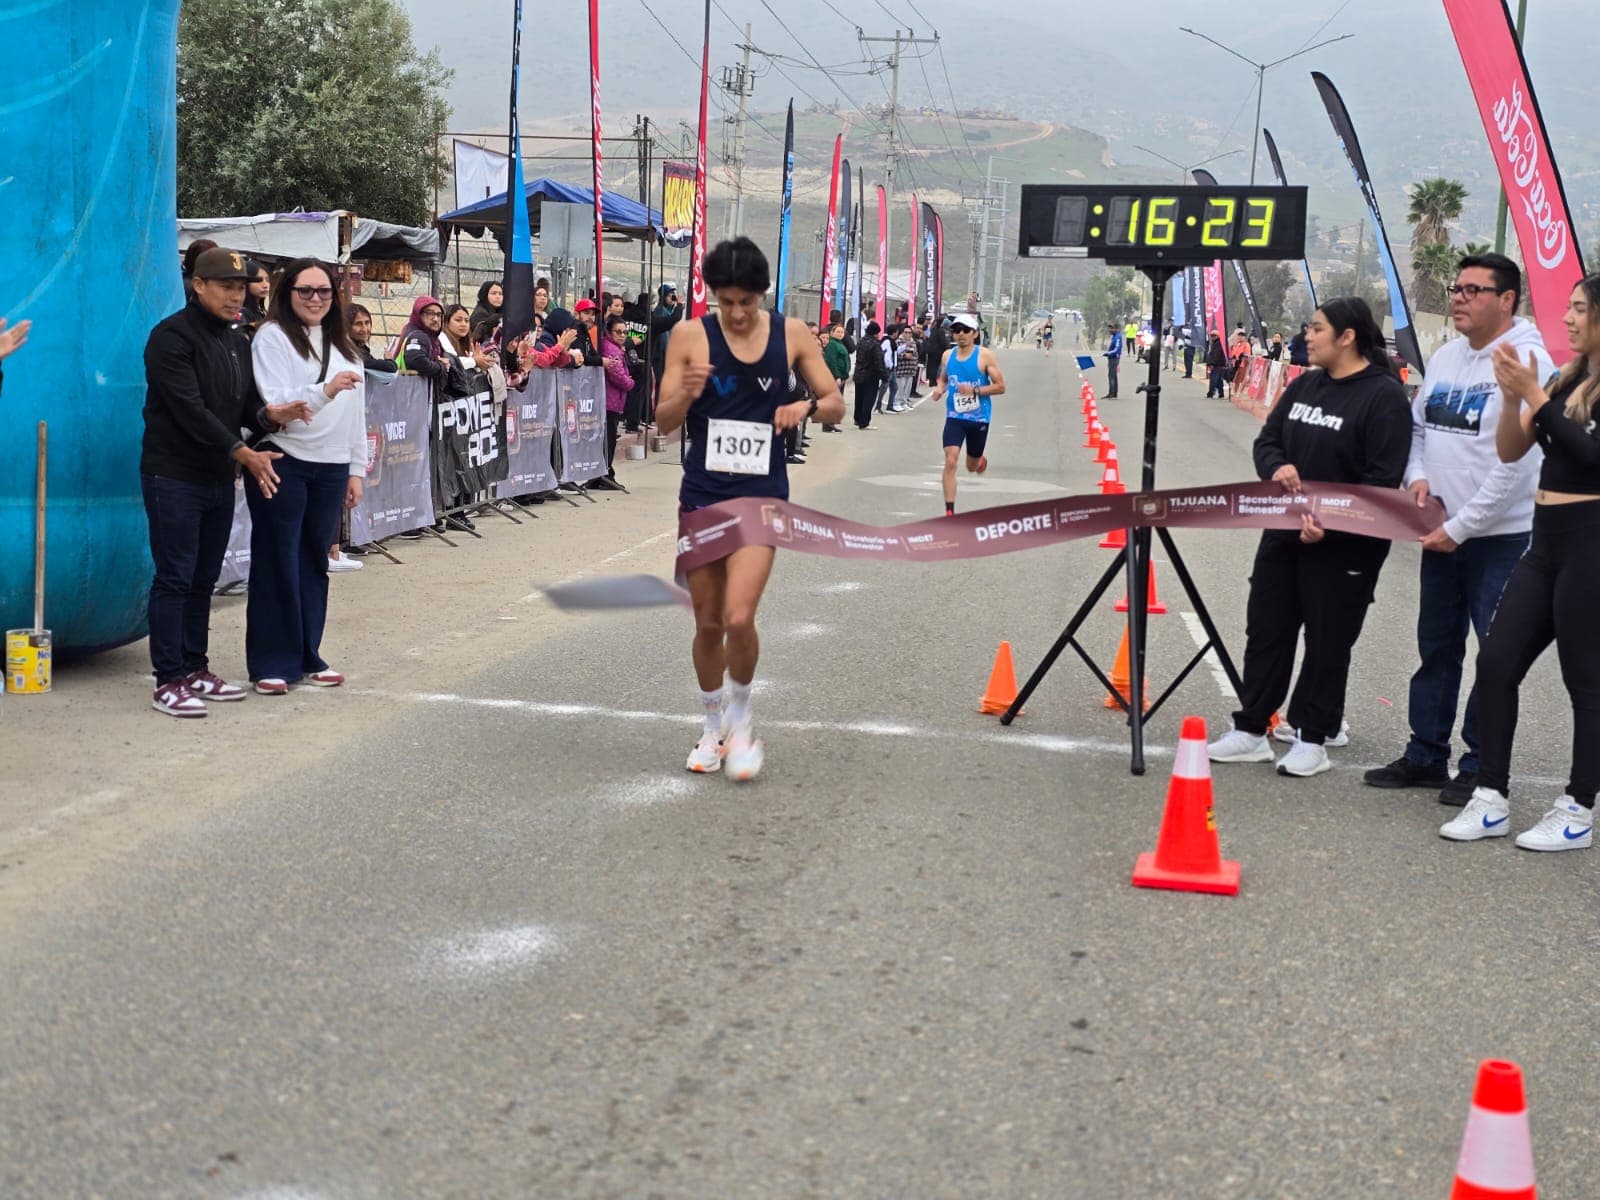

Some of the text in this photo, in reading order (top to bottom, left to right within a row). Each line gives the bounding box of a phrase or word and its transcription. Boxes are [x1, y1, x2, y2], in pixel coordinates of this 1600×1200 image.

[1288, 402, 1343, 431] Wilson
[713, 435, 766, 458] 1307
[1169, 495, 1228, 507] TIJUANA
[1238, 504, 1287, 515] Bienestar
[1294, 495, 1309, 505] de
[792, 518, 836, 540] TIJUANA
[975, 513, 1053, 542] DEPORTE
